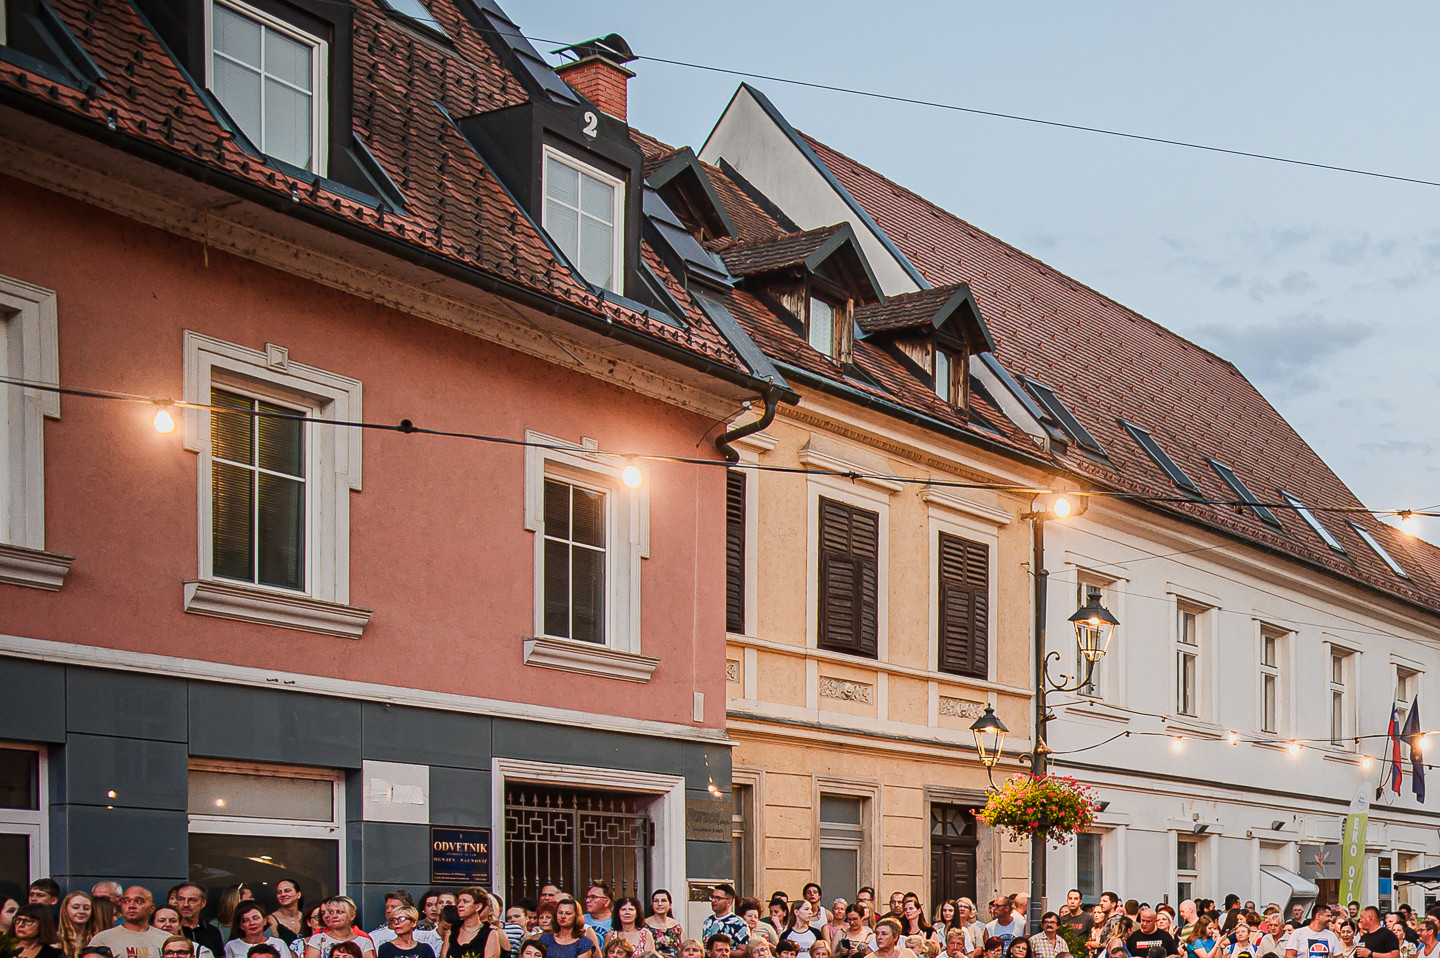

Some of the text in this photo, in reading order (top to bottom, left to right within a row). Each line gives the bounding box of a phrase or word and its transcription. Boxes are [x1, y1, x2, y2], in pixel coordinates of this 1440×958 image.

[582, 111, 598, 138] 2
[433, 841, 488, 853] ODVETNIK
[1350, 816, 1360, 857] EKO
